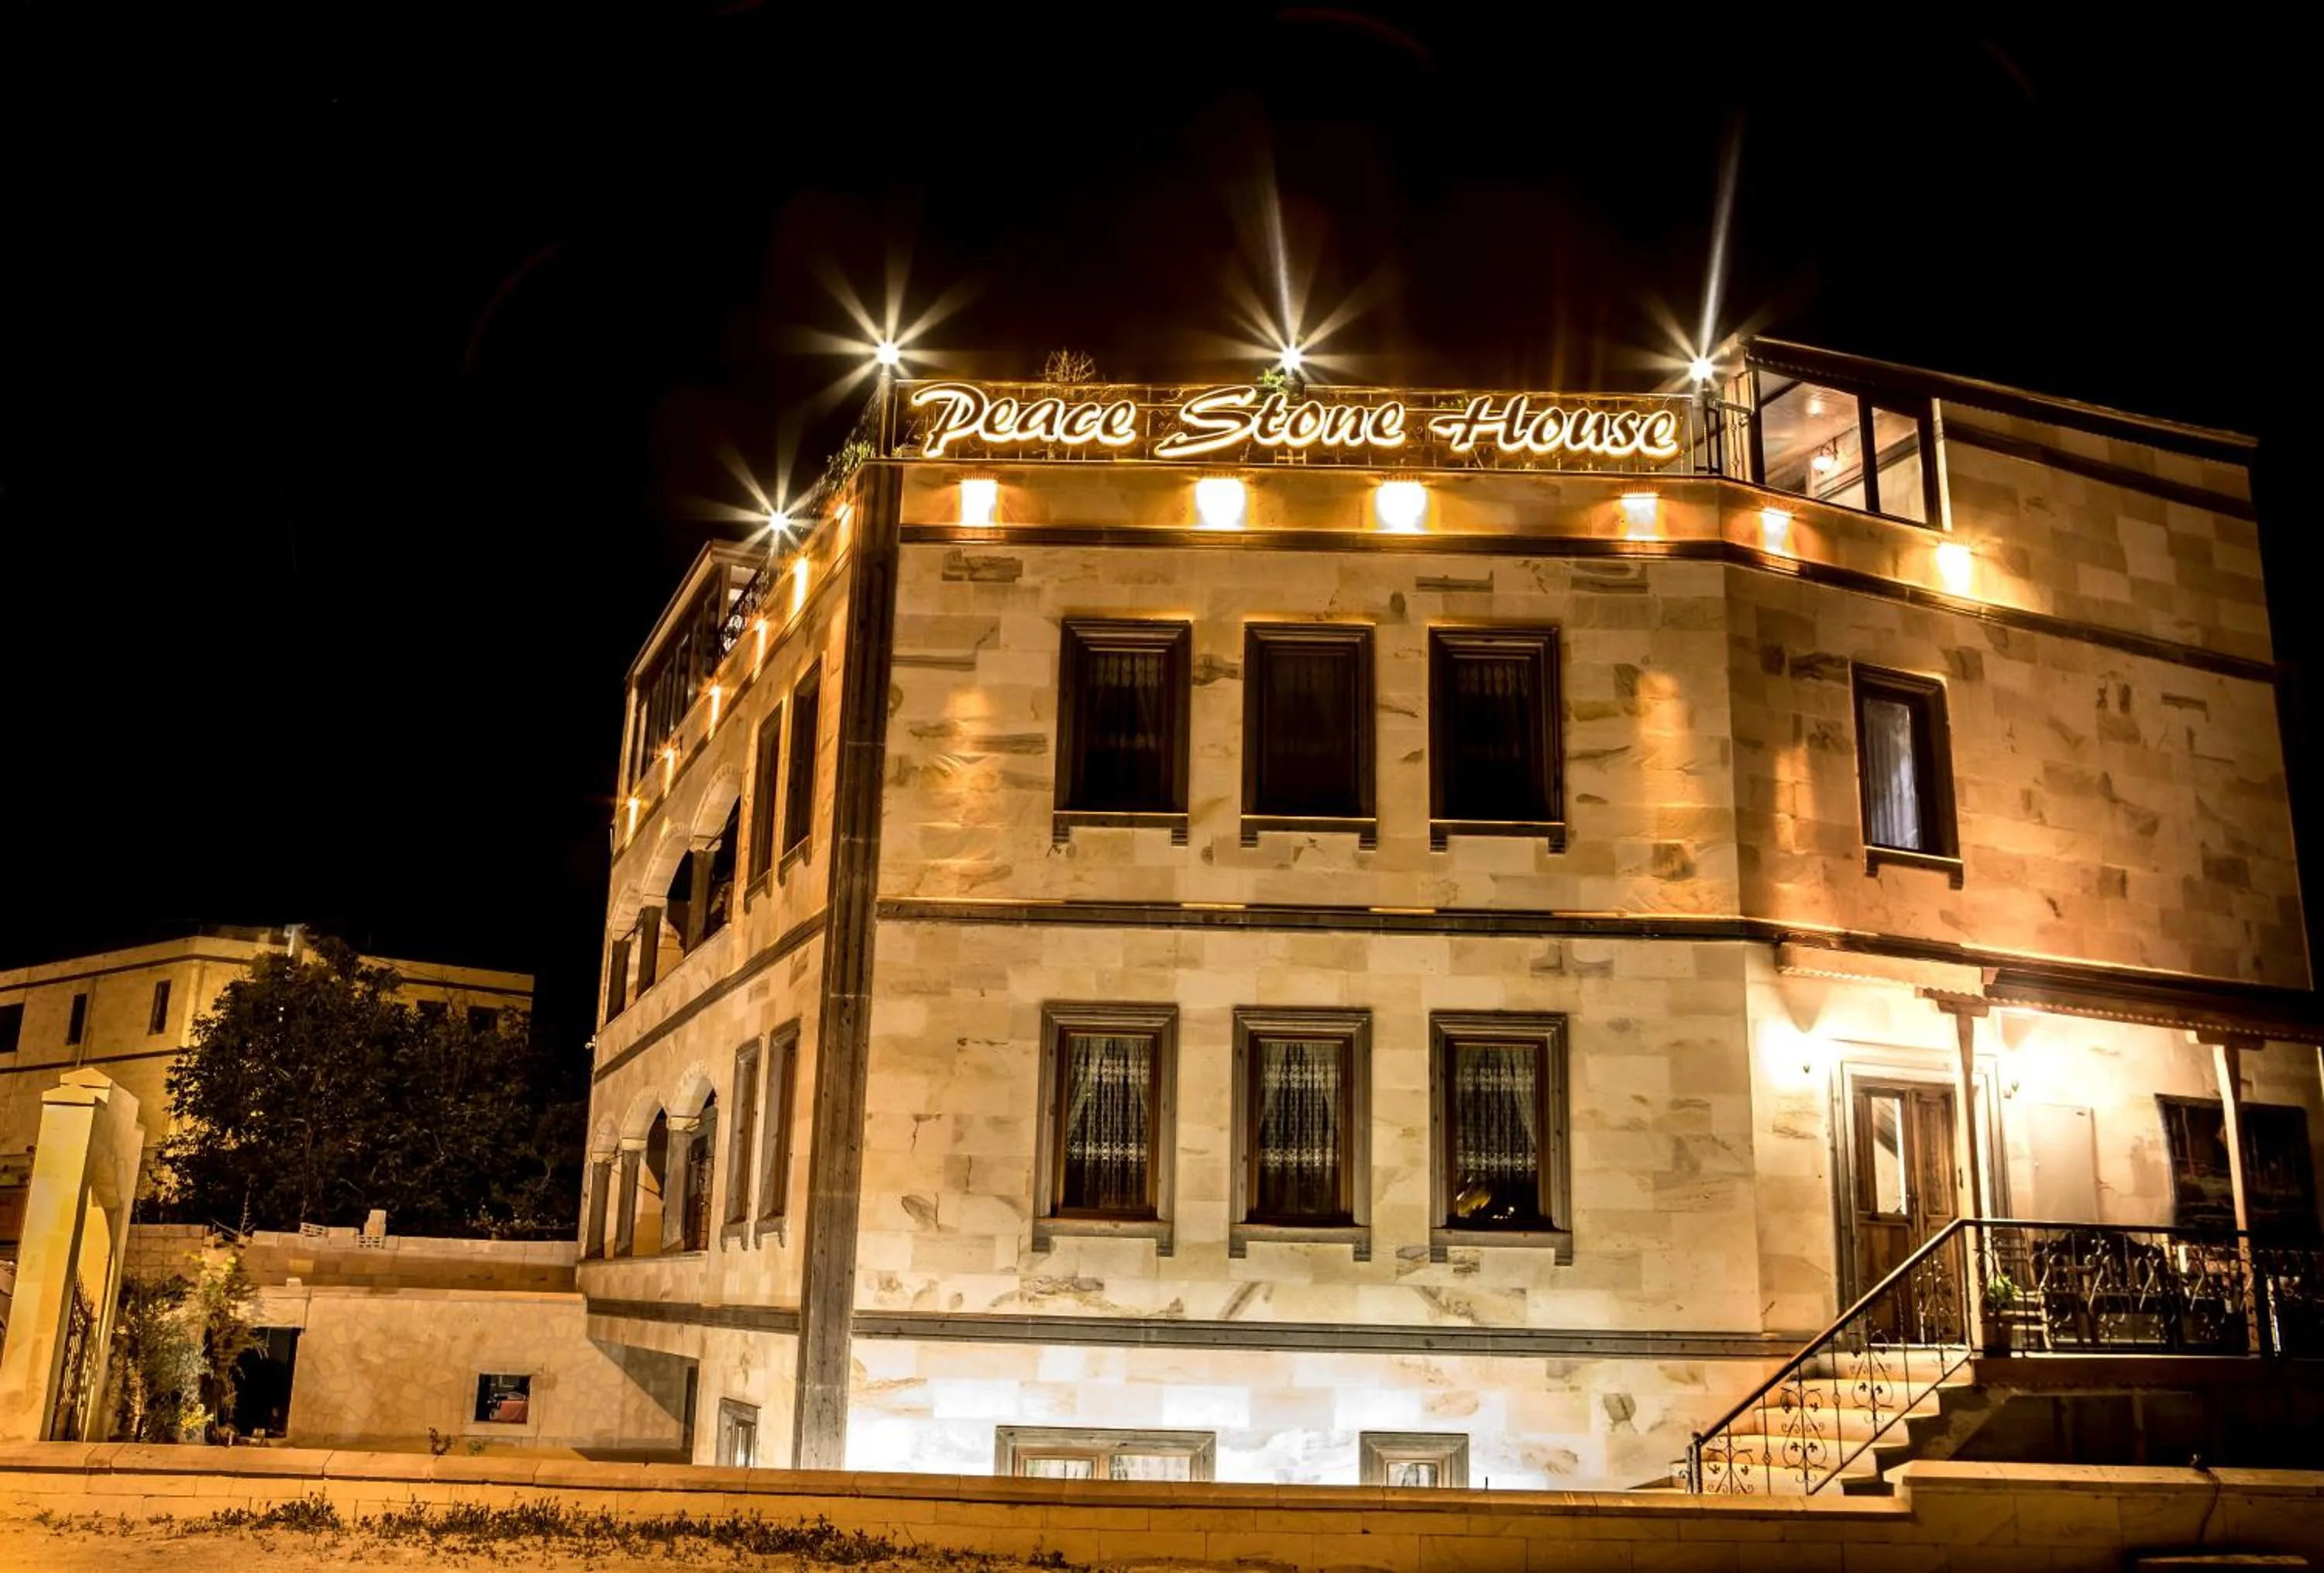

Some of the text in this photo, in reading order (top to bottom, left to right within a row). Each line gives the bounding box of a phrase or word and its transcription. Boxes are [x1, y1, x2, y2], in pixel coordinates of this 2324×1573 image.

[911, 383, 1679, 458] Peace Stone House
